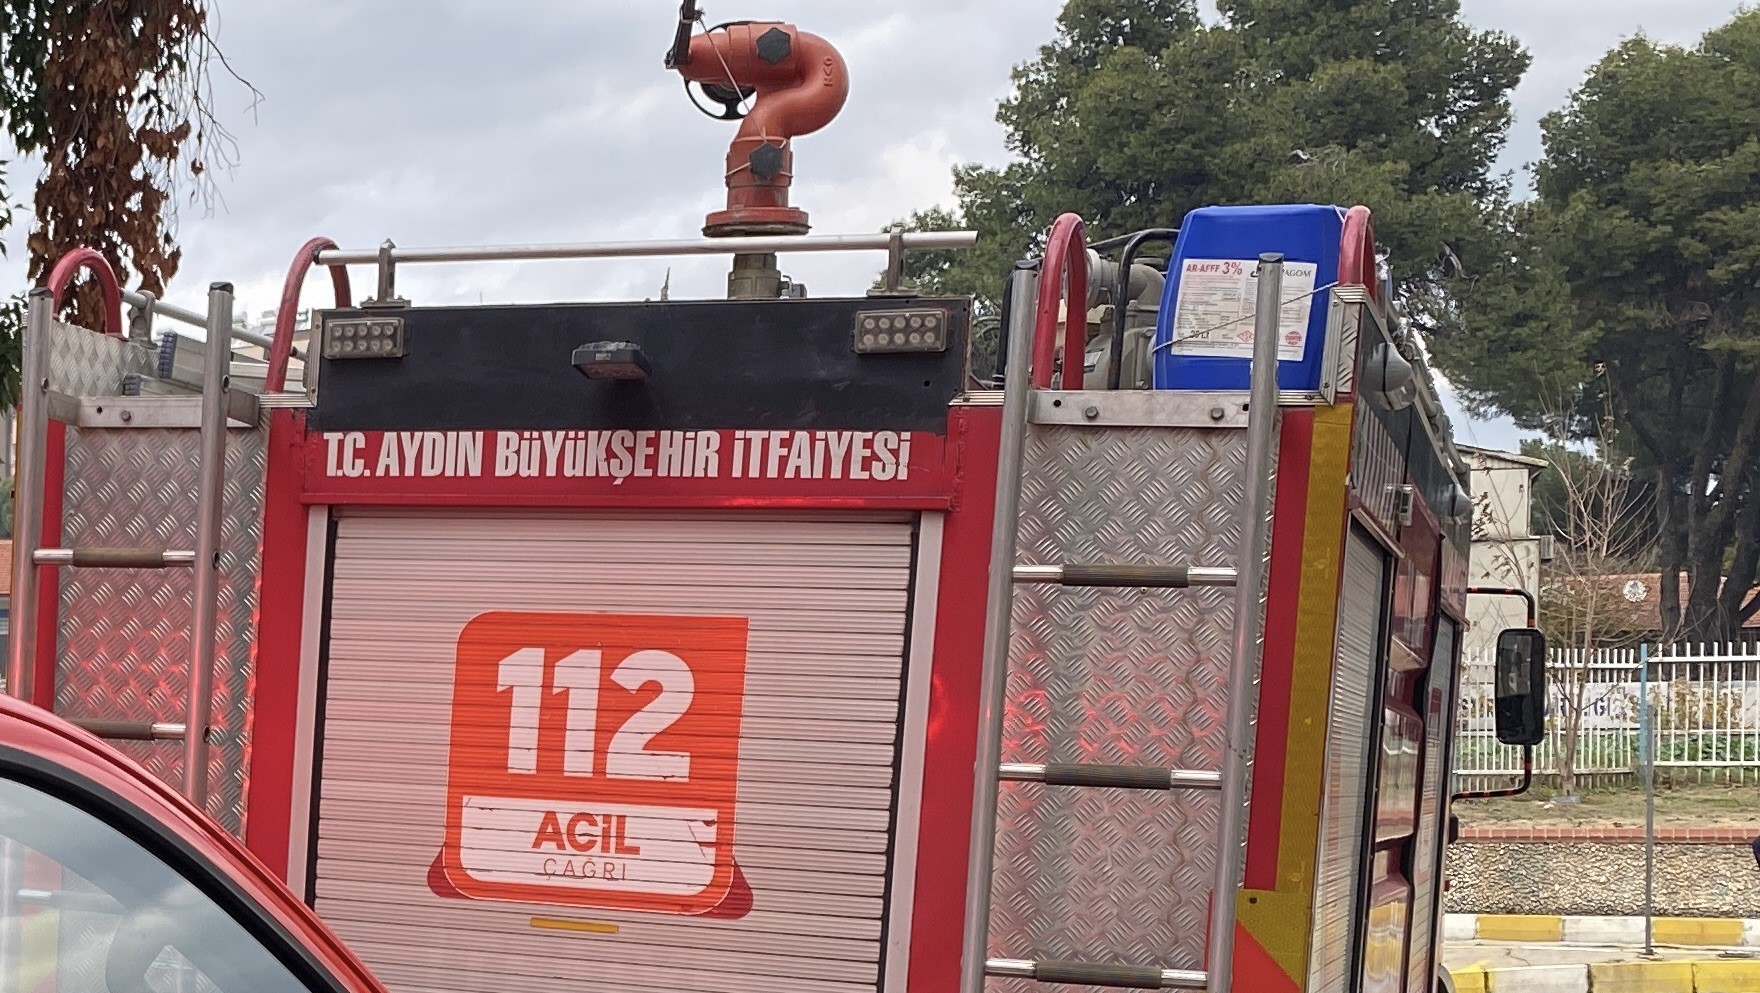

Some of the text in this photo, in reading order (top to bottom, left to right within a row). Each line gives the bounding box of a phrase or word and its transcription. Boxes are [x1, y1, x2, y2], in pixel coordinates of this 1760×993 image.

[1222, 261, 1243, 275] 3%
[323, 430, 912, 484] T.C. AYDIN BÜYÜKŞEHİR İTFAİYESİ
[496, 647, 696, 783] 112
[531, 810, 642, 856] ACİL
[543, 857, 627, 881] ÇAĞRI
